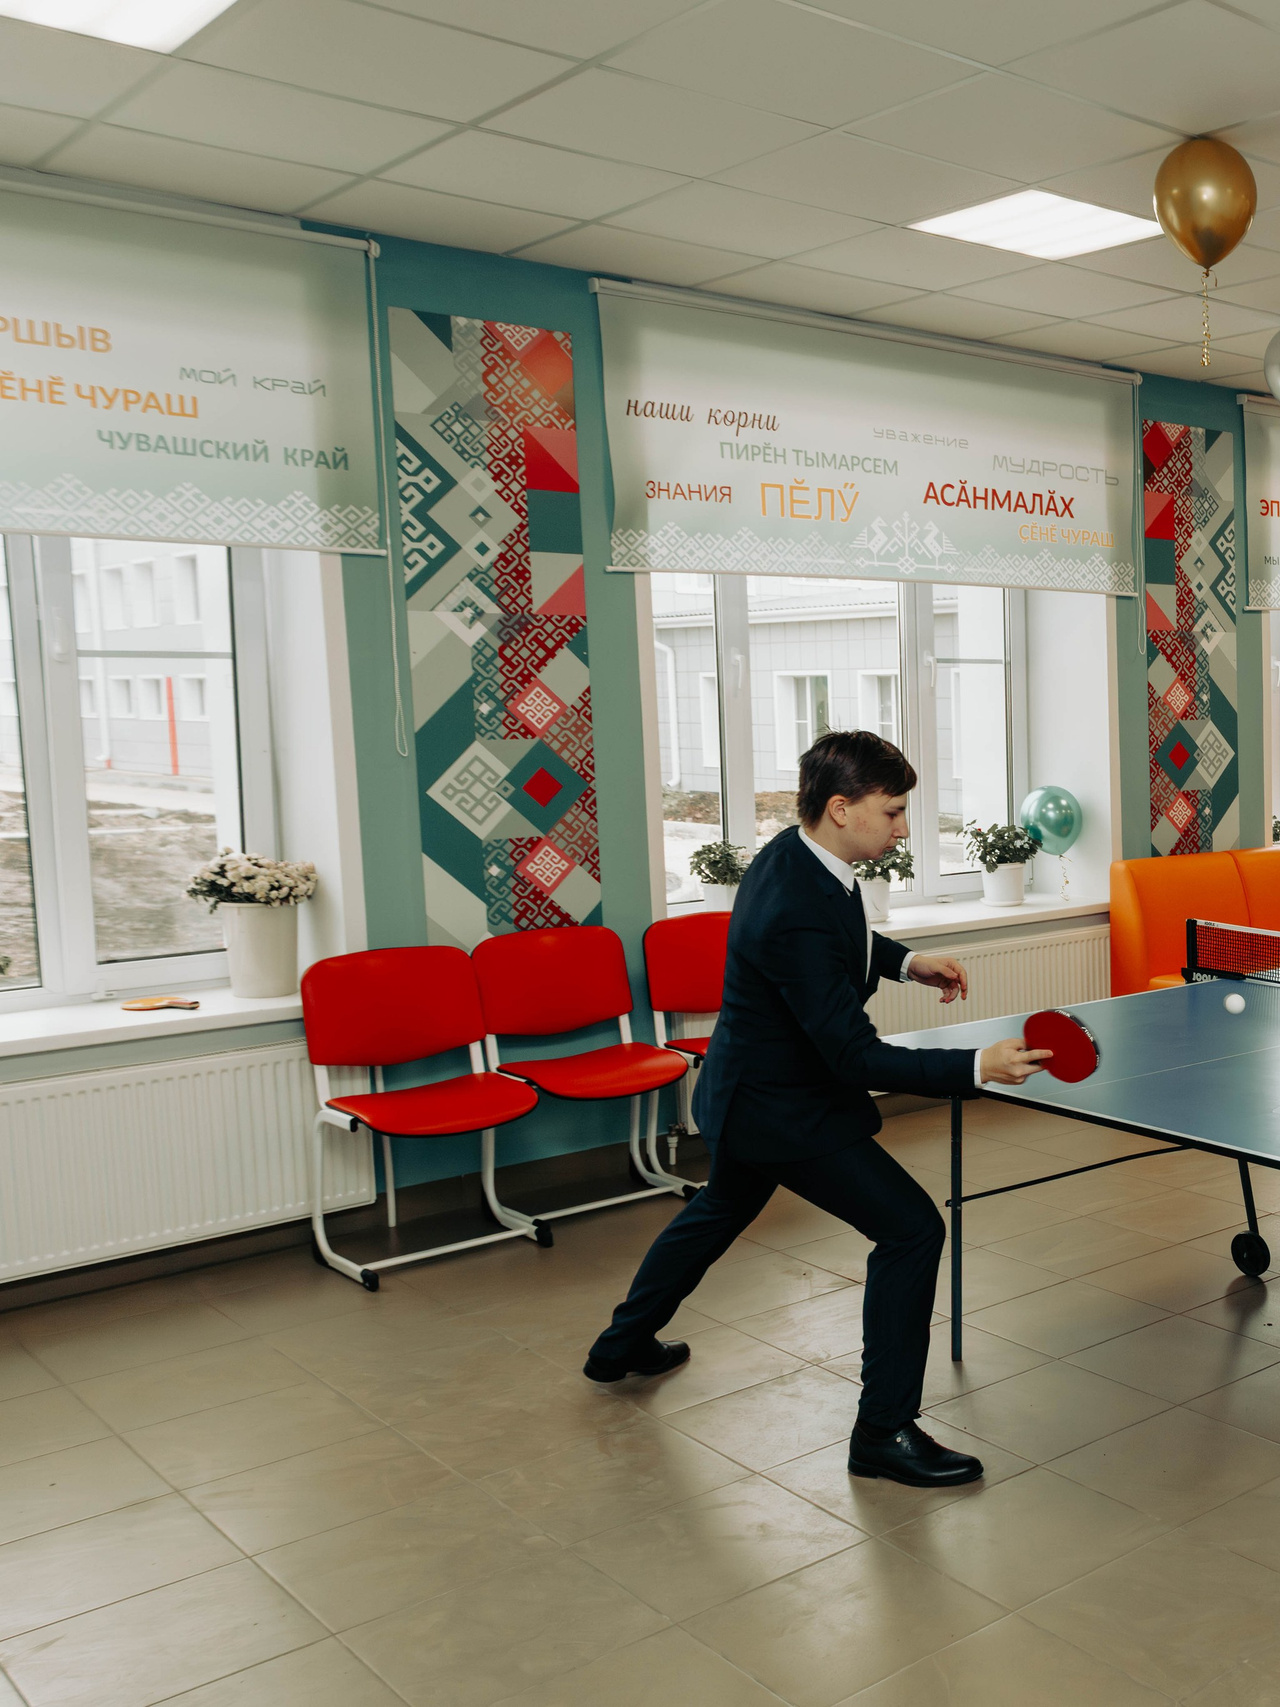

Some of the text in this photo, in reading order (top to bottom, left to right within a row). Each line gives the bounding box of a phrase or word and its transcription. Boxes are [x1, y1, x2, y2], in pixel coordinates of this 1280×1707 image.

[179, 366, 326, 397] мой край
[75, 383, 199, 418] ЧУРАШ
[626, 399, 779, 436] наши корни
[97, 429, 349, 471] ЧУВАШСКИЙ КРАЙ
[873, 427, 968, 449] уважение
[720, 442, 898, 476] ПИРӖН ТЫМАРСЕМ
[645, 480, 732, 503] ЗНАНИЯ
[923, 480, 1074, 518] АСӐНМАЛӐХ
[1061, 528, 1114, 548] ЧУРАШ
[1264, 555, 1280, 566] мы
